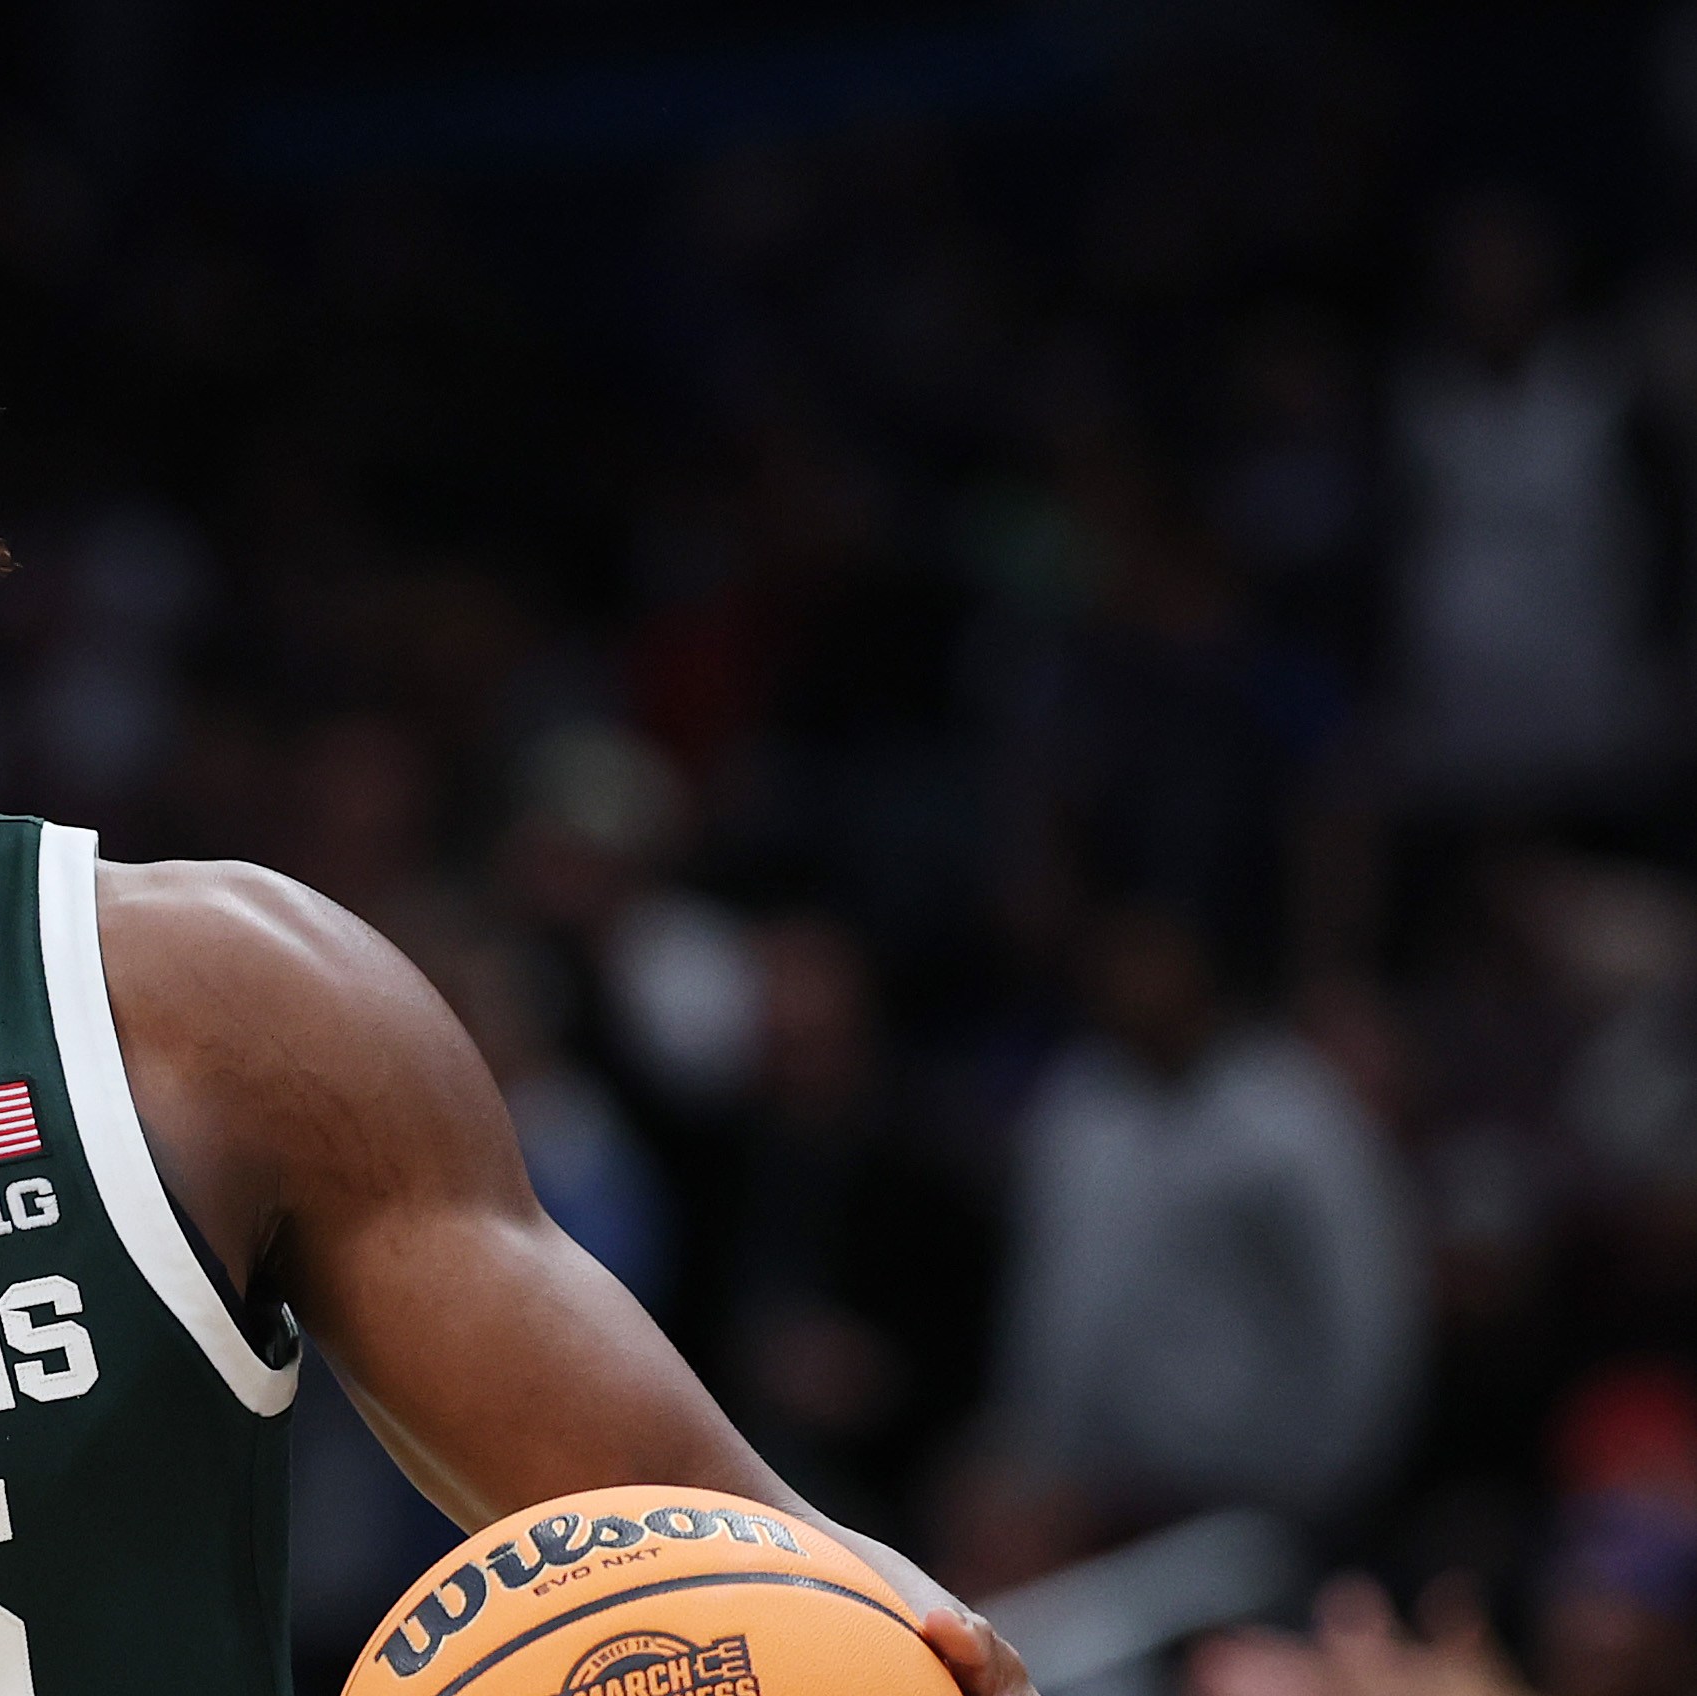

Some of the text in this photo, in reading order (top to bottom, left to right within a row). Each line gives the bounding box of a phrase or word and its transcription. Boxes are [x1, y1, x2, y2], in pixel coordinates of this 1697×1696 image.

[374, 1506, 811, 1678] Wilson
[532, 1546, 662, 1597] EVO NXT
